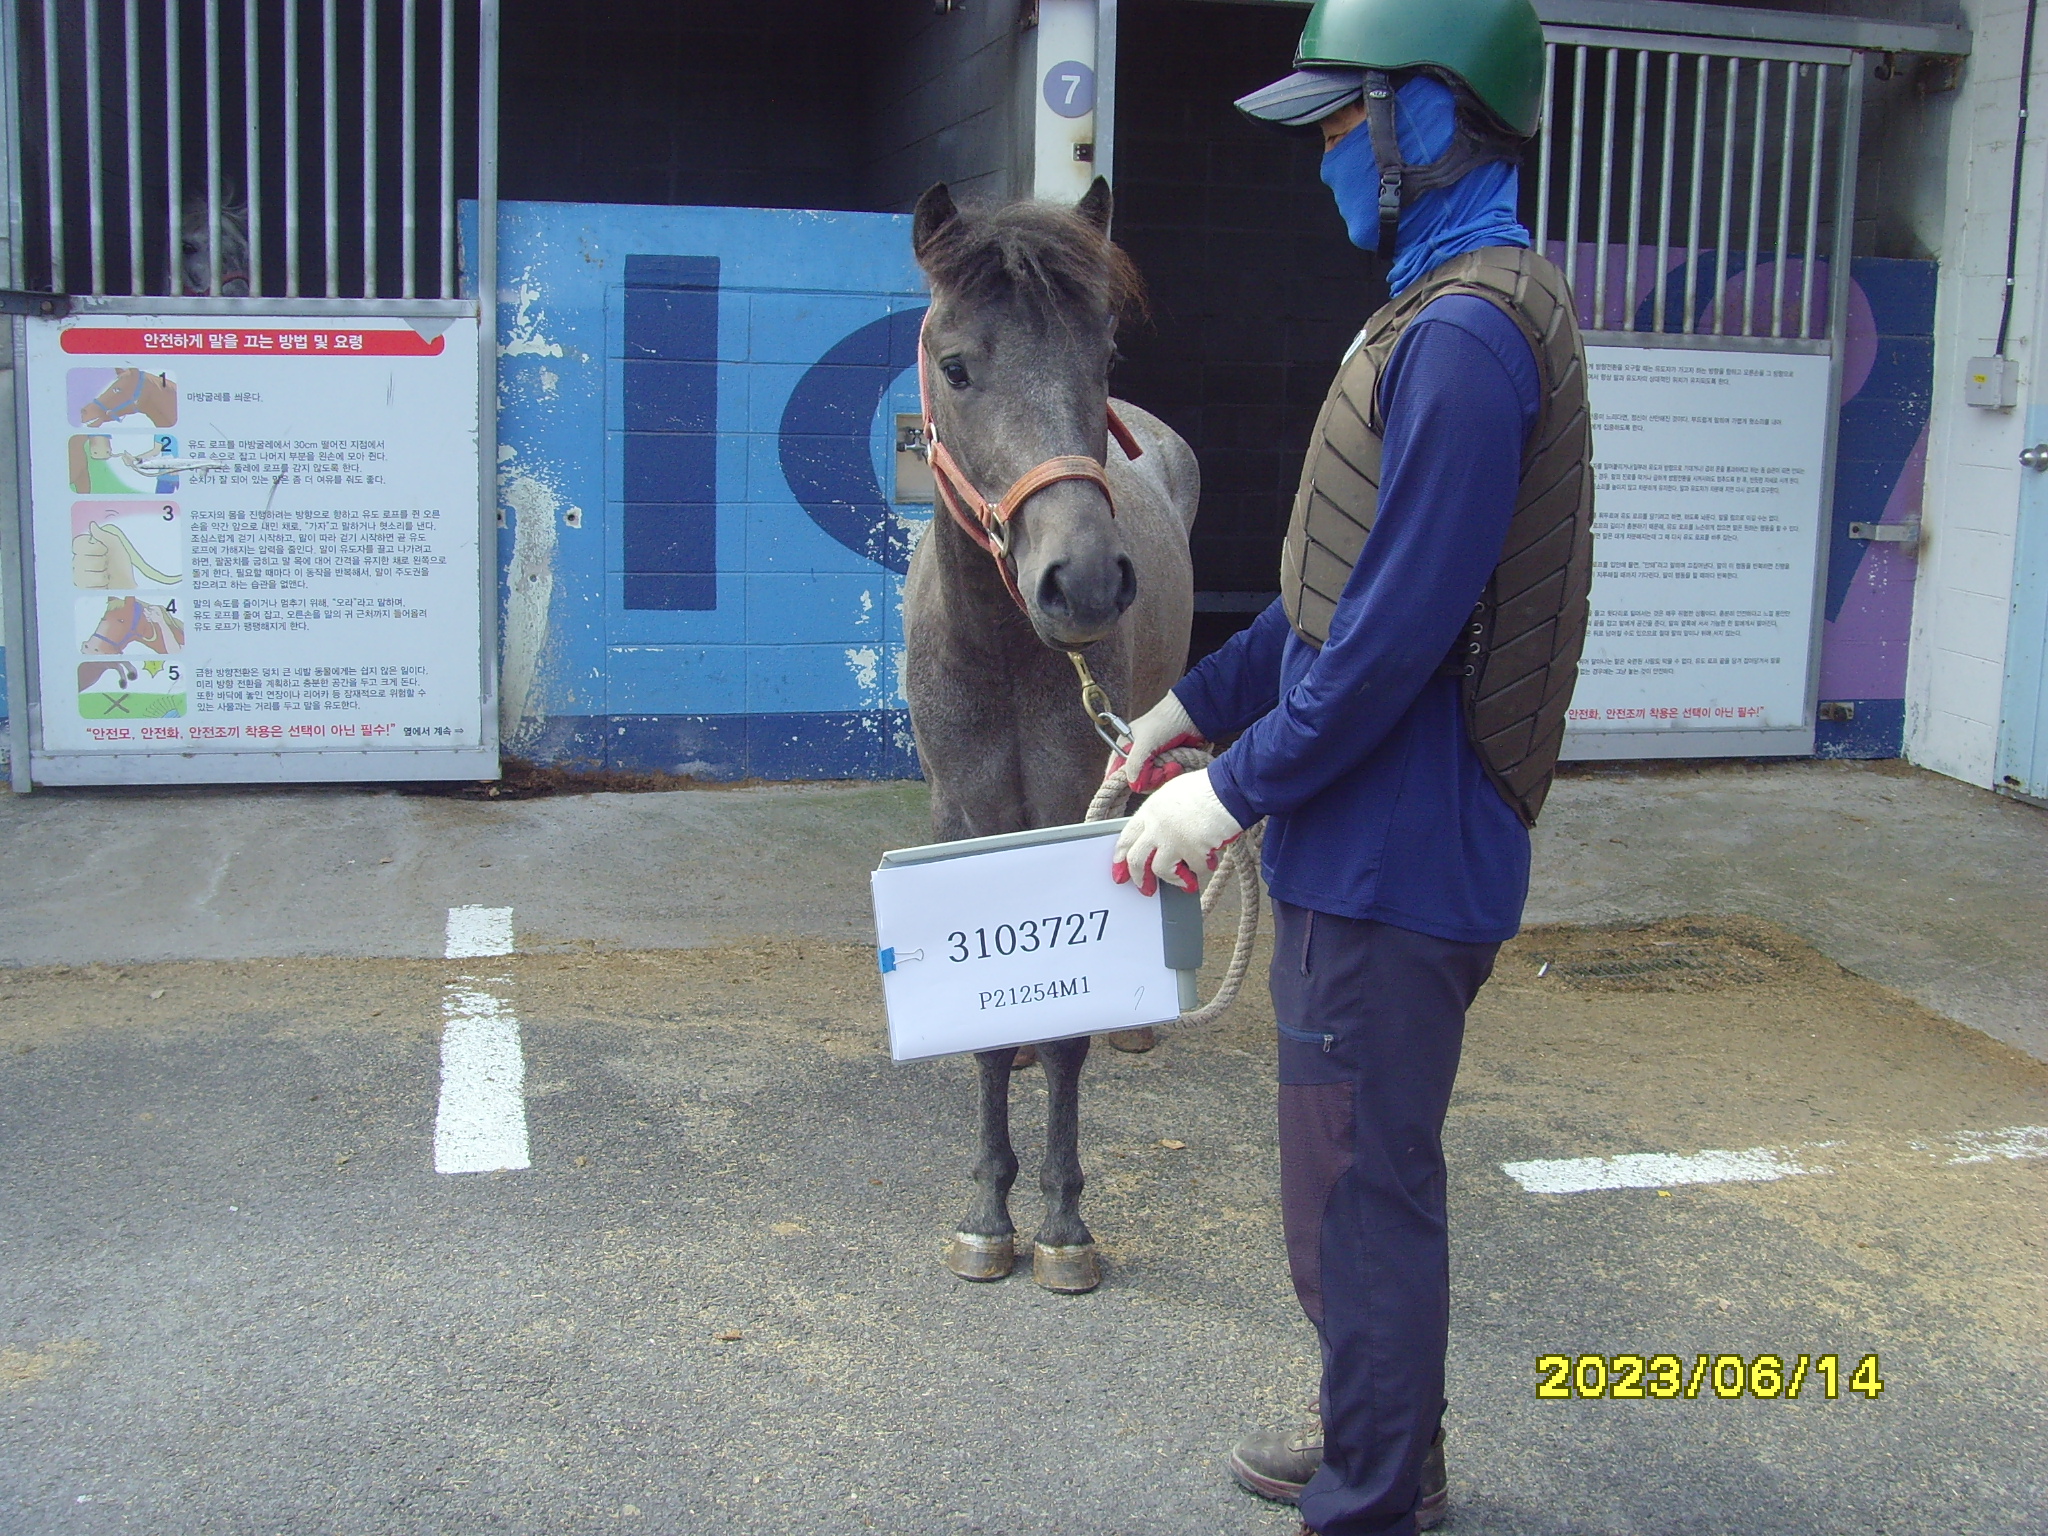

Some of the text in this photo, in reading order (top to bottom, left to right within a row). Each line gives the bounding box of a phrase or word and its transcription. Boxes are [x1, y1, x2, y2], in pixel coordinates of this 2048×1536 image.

[1061, 74, 1081, 105] 7
[143, 333, 362, 349] 안전하게 말을 끄는 방법 및 요령
[159, 371, 166, 388] 1
[186, 392, 263, 402] 마방굴레를 씌운다.
[160, 437, 172, 452] 2
[187, 439, 384, 450] 유도 로프를 마방굴레에서 30cm 떨어진 지점에서
[163, 506, 174, 521] 3
[192, 578, 308, 590] 잡으려고 하는 습관을 없앤다.
[165, 600, 178, 614] 4
[168, 666, 180, 681] 5
[1567, 708, 1601, 720] 안전화,
[1605, 708, 1645, 719] 안전조끼
[1649, 707, 1679, 719] 착용은
[1682, 707, 1711, 718] 선택이
[1714, 707, 1733, 718] 아닌
[140, 726, 183, 739] 안전화,
[188, 726, 239, 738] 안전조끼
[245, 725, 283, 738] 착용은
[288, 724, 325, 737] 선택이
[330, 724, 355, 736] 아닌
[403, 726, 452, 737] 옆에서 계속
[947, 909, 1109, 963] 3103727
[978, 976, 1091, 1010] P21254M1
